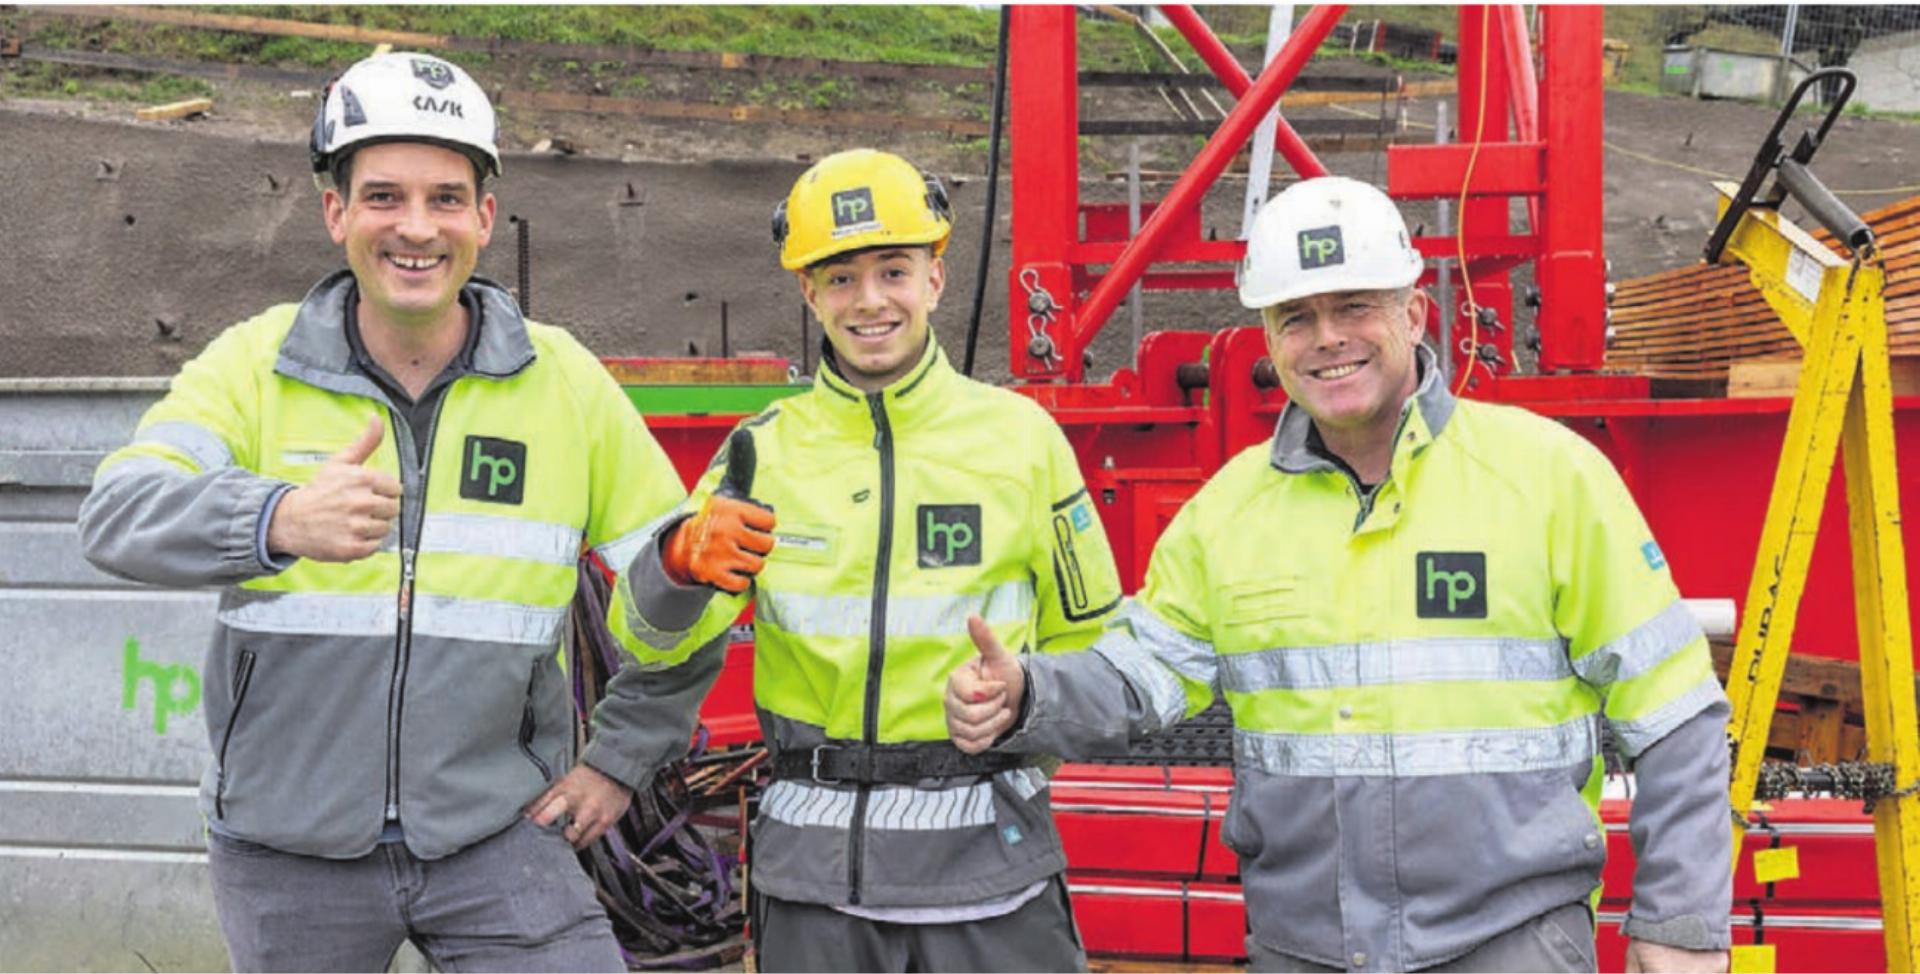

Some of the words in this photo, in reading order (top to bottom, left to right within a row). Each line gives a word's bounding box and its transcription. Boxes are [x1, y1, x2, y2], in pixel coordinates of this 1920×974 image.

[836, 195, 868, 221] hp
[1303, 233, 1337, 264] hp
[471, 440, 517, 496] hp
[926, 510, 973, 562] hp
[1426, 557, 1476, 612] hp
[122, 634, 203, 736] hp
